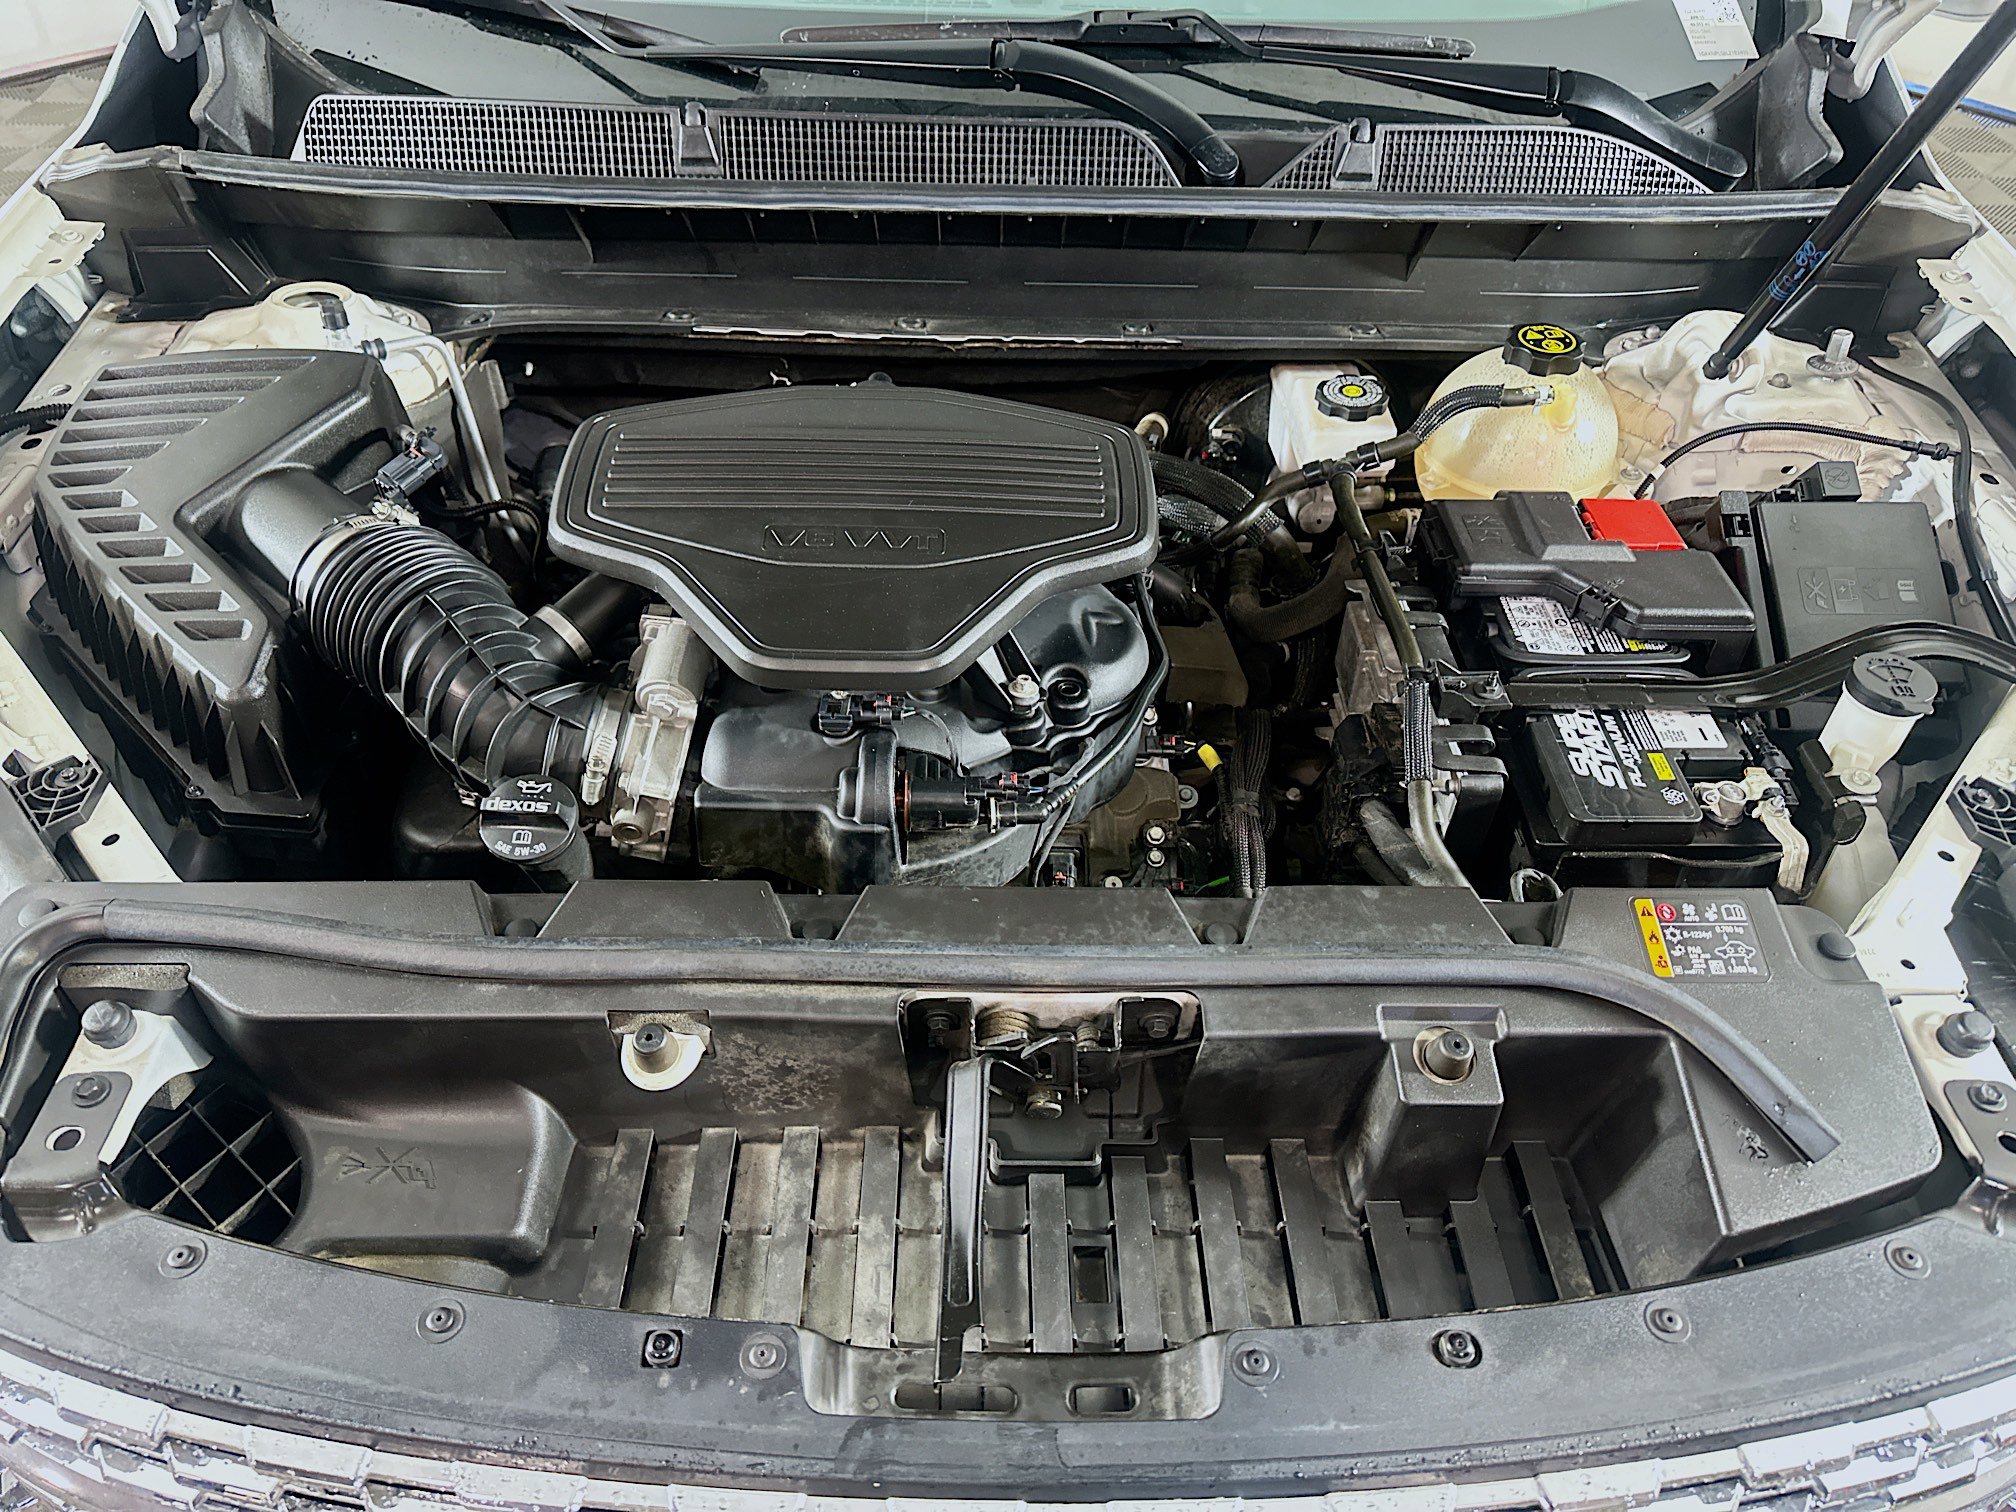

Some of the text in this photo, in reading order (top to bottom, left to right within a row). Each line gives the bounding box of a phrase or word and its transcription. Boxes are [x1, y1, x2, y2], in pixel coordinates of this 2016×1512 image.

[770, 528, 939, 550] V6 VVT
[1552, 712, 1590, 777] SUPE
[1600, 713, 1647, 787] PLATINUM
[485, 796, 552, 813] dexos
[494, 840, 547, 856] SAE 5W-30
